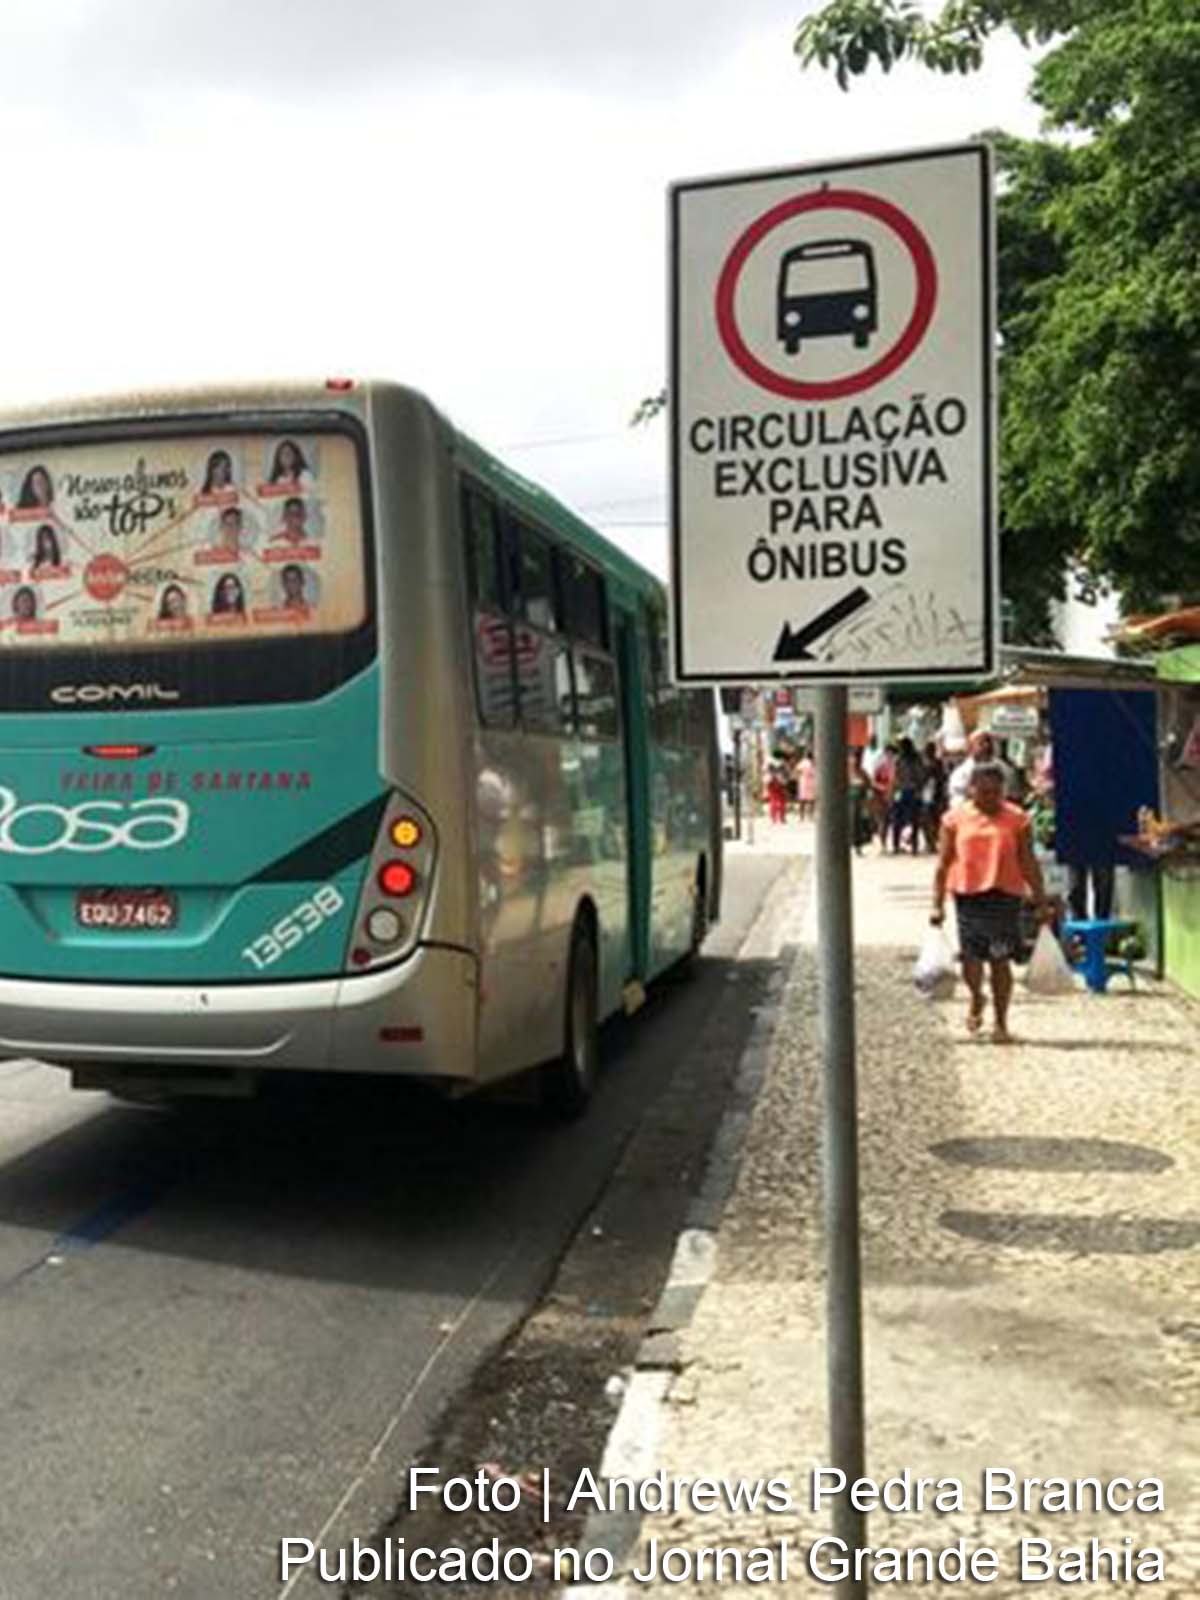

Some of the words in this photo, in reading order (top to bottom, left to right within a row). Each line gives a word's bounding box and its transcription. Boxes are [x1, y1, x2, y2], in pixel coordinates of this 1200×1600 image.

[690, 394, 967, 454] CIRCULAÇÃO
[715, 447, 947, 497] EXCLUSIVA
[770, 494, 882, 533] PARA
[747, 537, 907, 582] ÔNIBUS
[50, 683, 180, 703] COMIL
[241, 885, 344, 971] 13538
